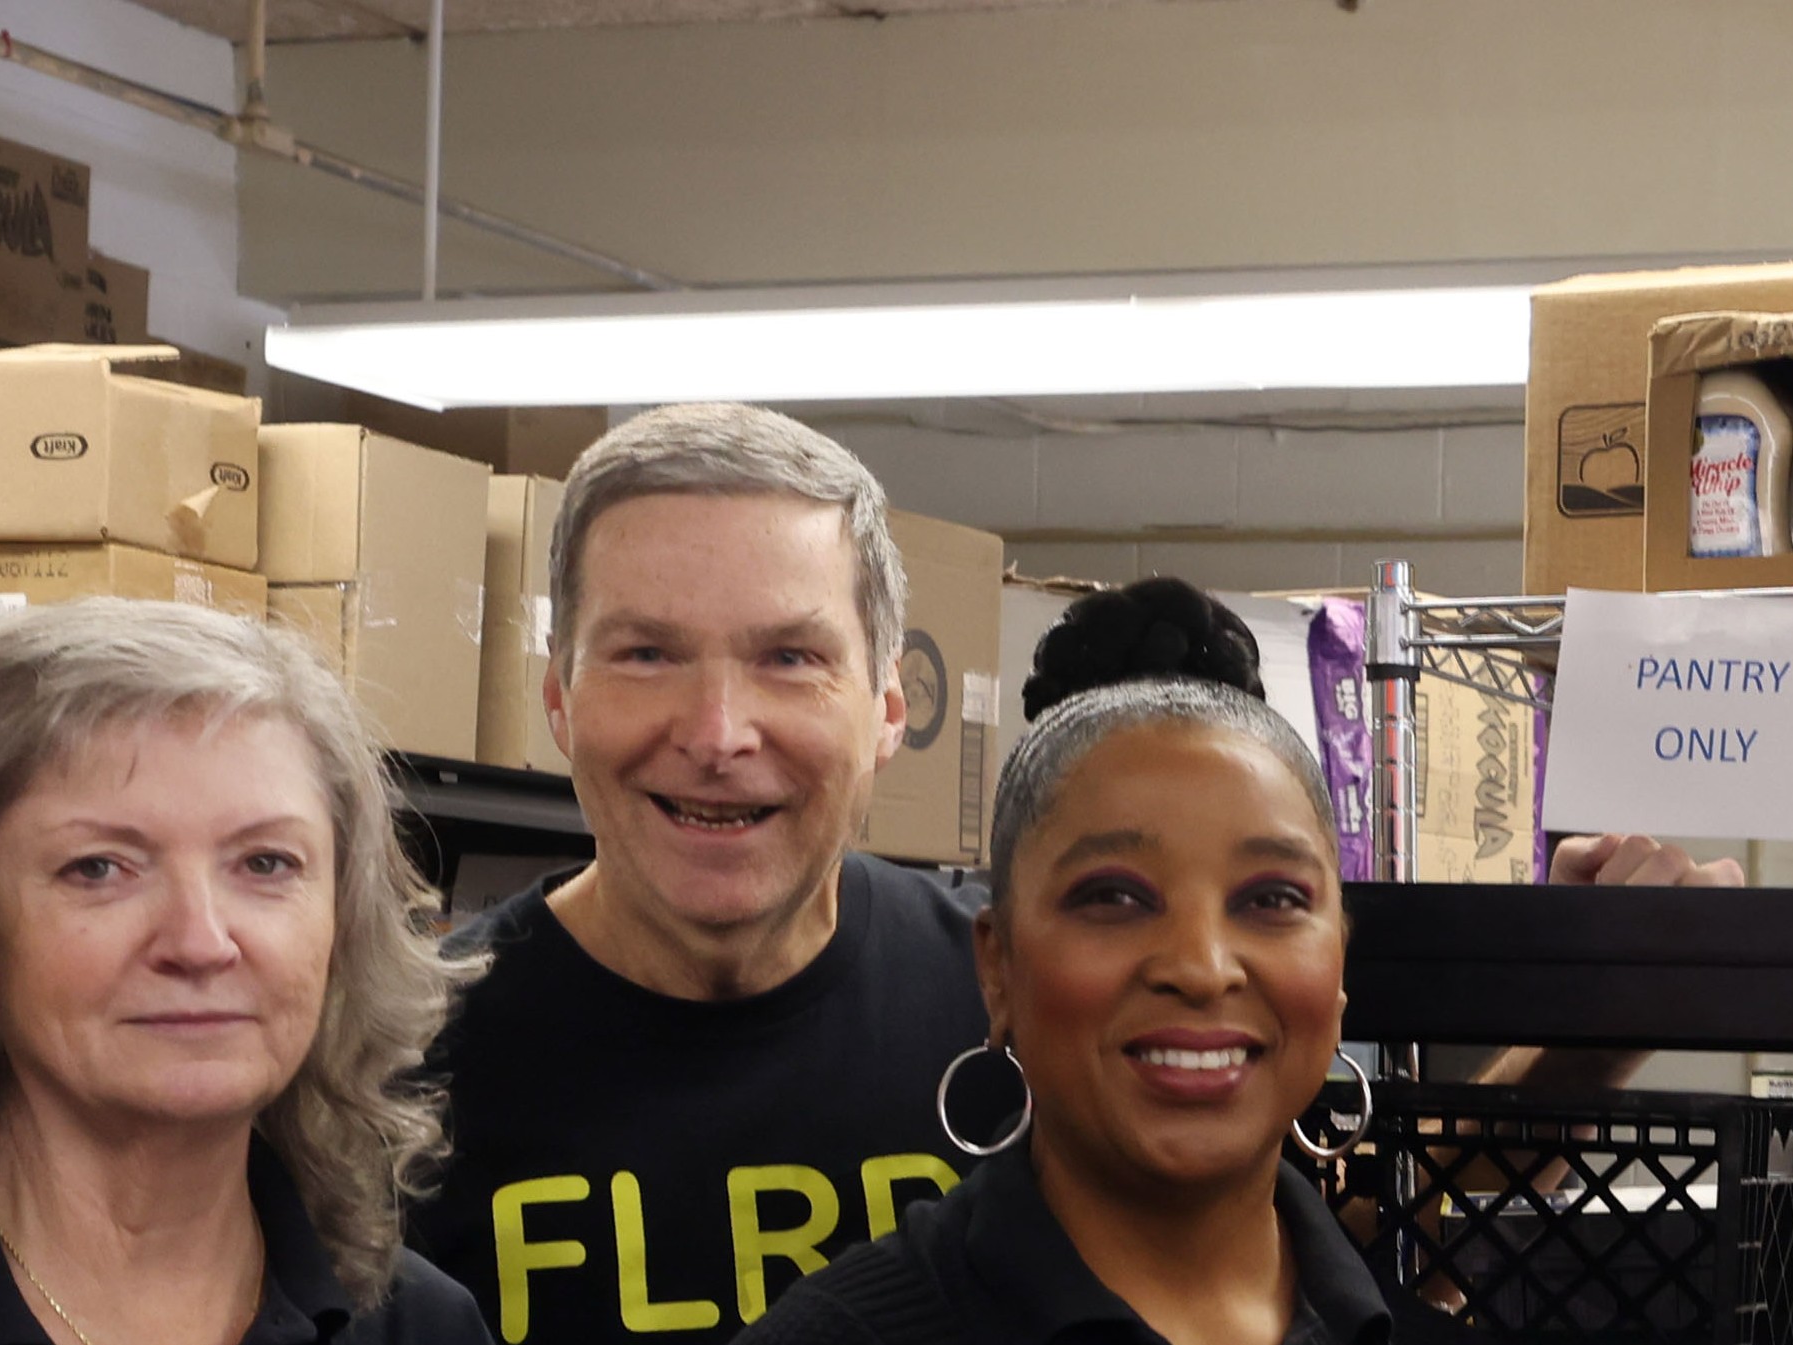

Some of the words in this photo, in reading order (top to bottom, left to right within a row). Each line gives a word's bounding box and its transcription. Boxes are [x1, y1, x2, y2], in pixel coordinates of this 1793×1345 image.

[41, 438, 79, 457] Kraft
[1690, 452, 1753, 481] Miracle
[1692, 473, 1741, 497] Whip
[1637, 657, 1791, 694] PANTRY
[1655, 726, 1759, 763] ONLY
